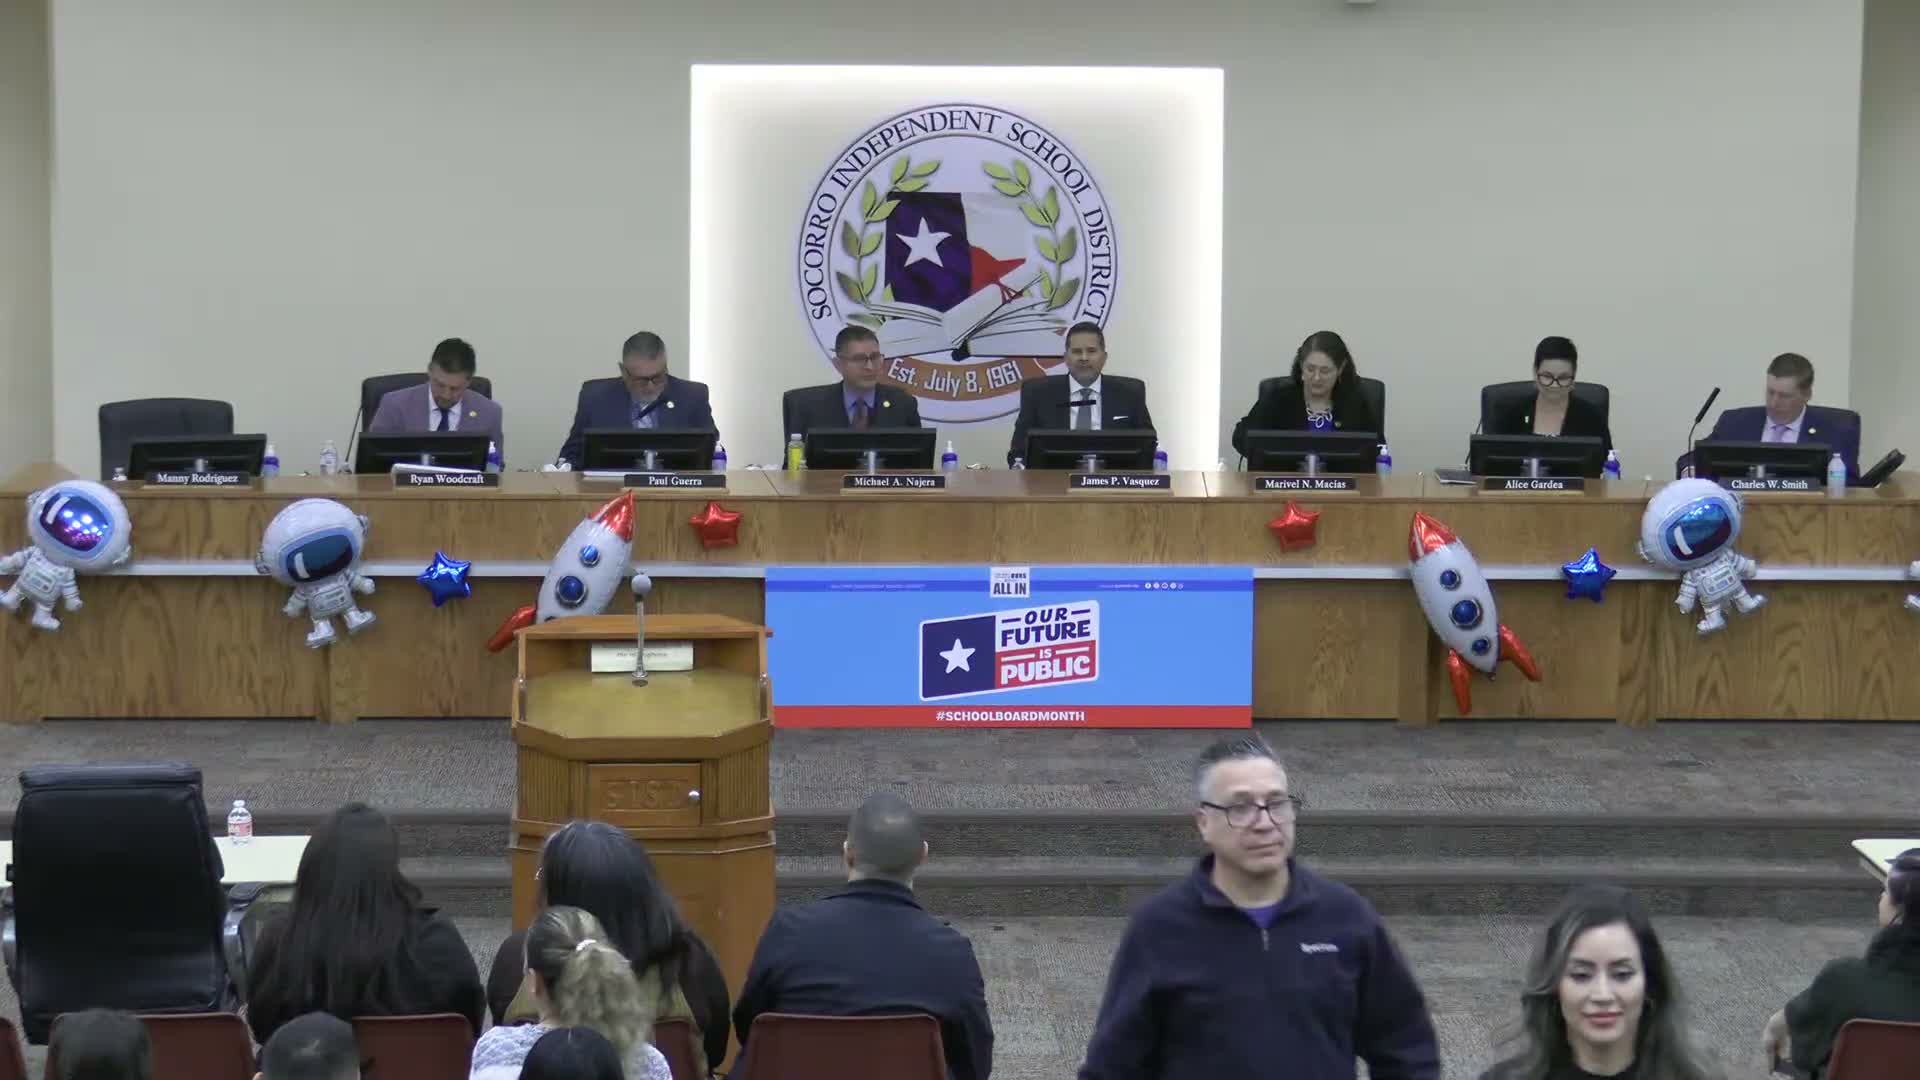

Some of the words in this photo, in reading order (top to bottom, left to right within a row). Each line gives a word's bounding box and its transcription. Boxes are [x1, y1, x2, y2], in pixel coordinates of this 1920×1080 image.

[804, 193, 837, 320] SOCORRO
[830, 110, 1002, 190] INDEPENDENT
[1007, 122, 1092, 204] SCHOOL
[1082, 207, 1112, 326] DISTRICT
[888, 358, 918, 386] Est.
[924, 369, 960, 398] July
[966, 371, 983, 394] 8,
[986, 360, 1022, 389] 1961
[158, 473, 190, 485] Manny
[191, 473, 239, 485] Rodriguez
[410, 474, 434, 486] Ryan
[435, 474, 484, 484] Woodcraft
[649, 476, 668, 485] Paul
[671, 476, 702, 486] Guerra
[855, 477, 889, 486] Michael
[892, 477, 903, 486] A.
[906, 477, 935, 488] Najera
[1081, 476, 1109, 486] James
[1111, 476, 1120, 485] P.
[1122, 476, 1160, 488] Vasquez
[1265, 479, 1300, 489] Marivel
[1302, 479, 1313, 489] N.
[1315, 479, 1346, 489] Macias
[1505, 479, 1529, 489] Alice
[1531, 479, 1564, 489] Gardea
[1731, 479, 1765, 489] Charles
[1767, 479, 1780, 489] W.
[1782, 479, 1808, 489] Smith
[993, 582, 1012, 595] ALL
[1014, 582, 1027, 595] IN
[1024, 607, 1068, 625] OUR
[1001, 620, 1091, 647] FUTURE
[1040, 648, 1052, 659] IS
[1001, 656, 1091, 685] PUBLIC
[936, 711, 1085, 721] #SCHOOLBOARDMONTH
